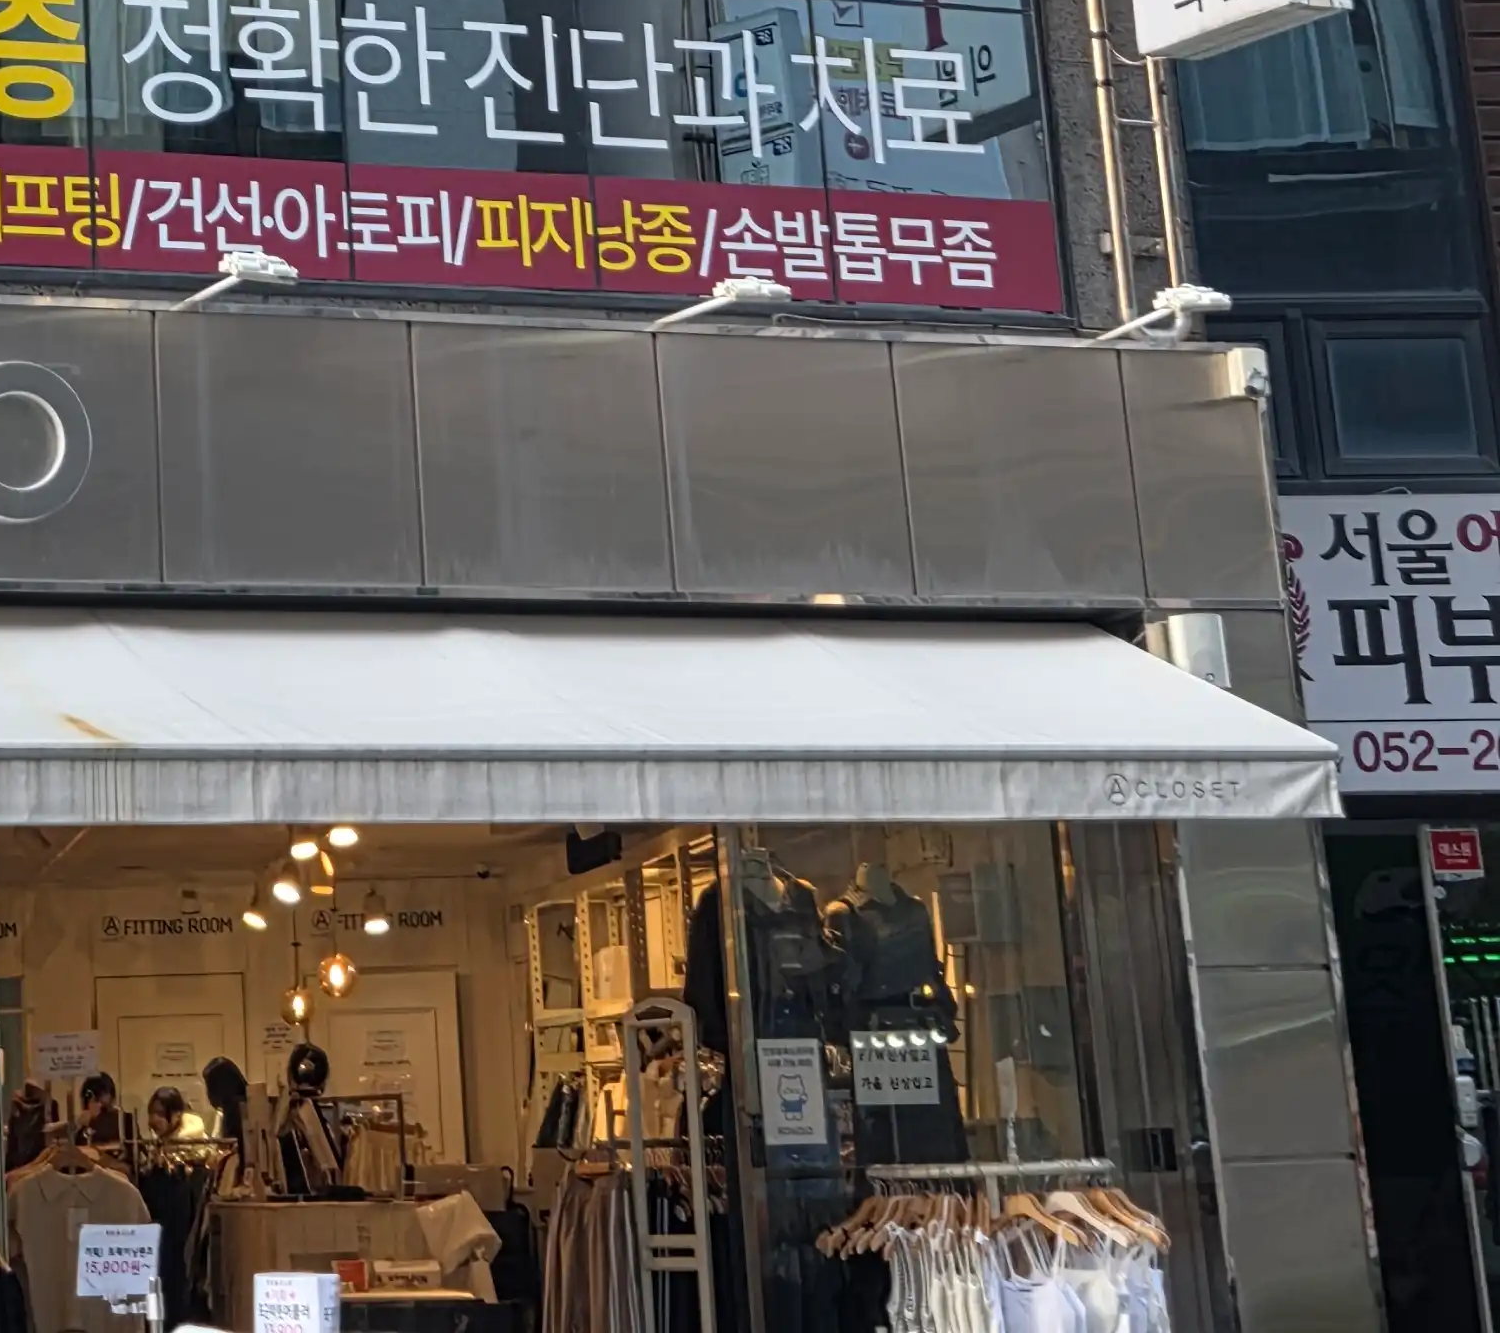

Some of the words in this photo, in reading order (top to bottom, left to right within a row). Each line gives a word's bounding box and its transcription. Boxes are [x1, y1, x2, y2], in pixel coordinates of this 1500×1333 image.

[461, 15, 777, 161] 진단과
[790, 31, 987, 166] 치료
[124, 918, 183, 935] FITTING
[188, 916, 233, 933] ROOM
[399, 911, 443, 928] ROOM
